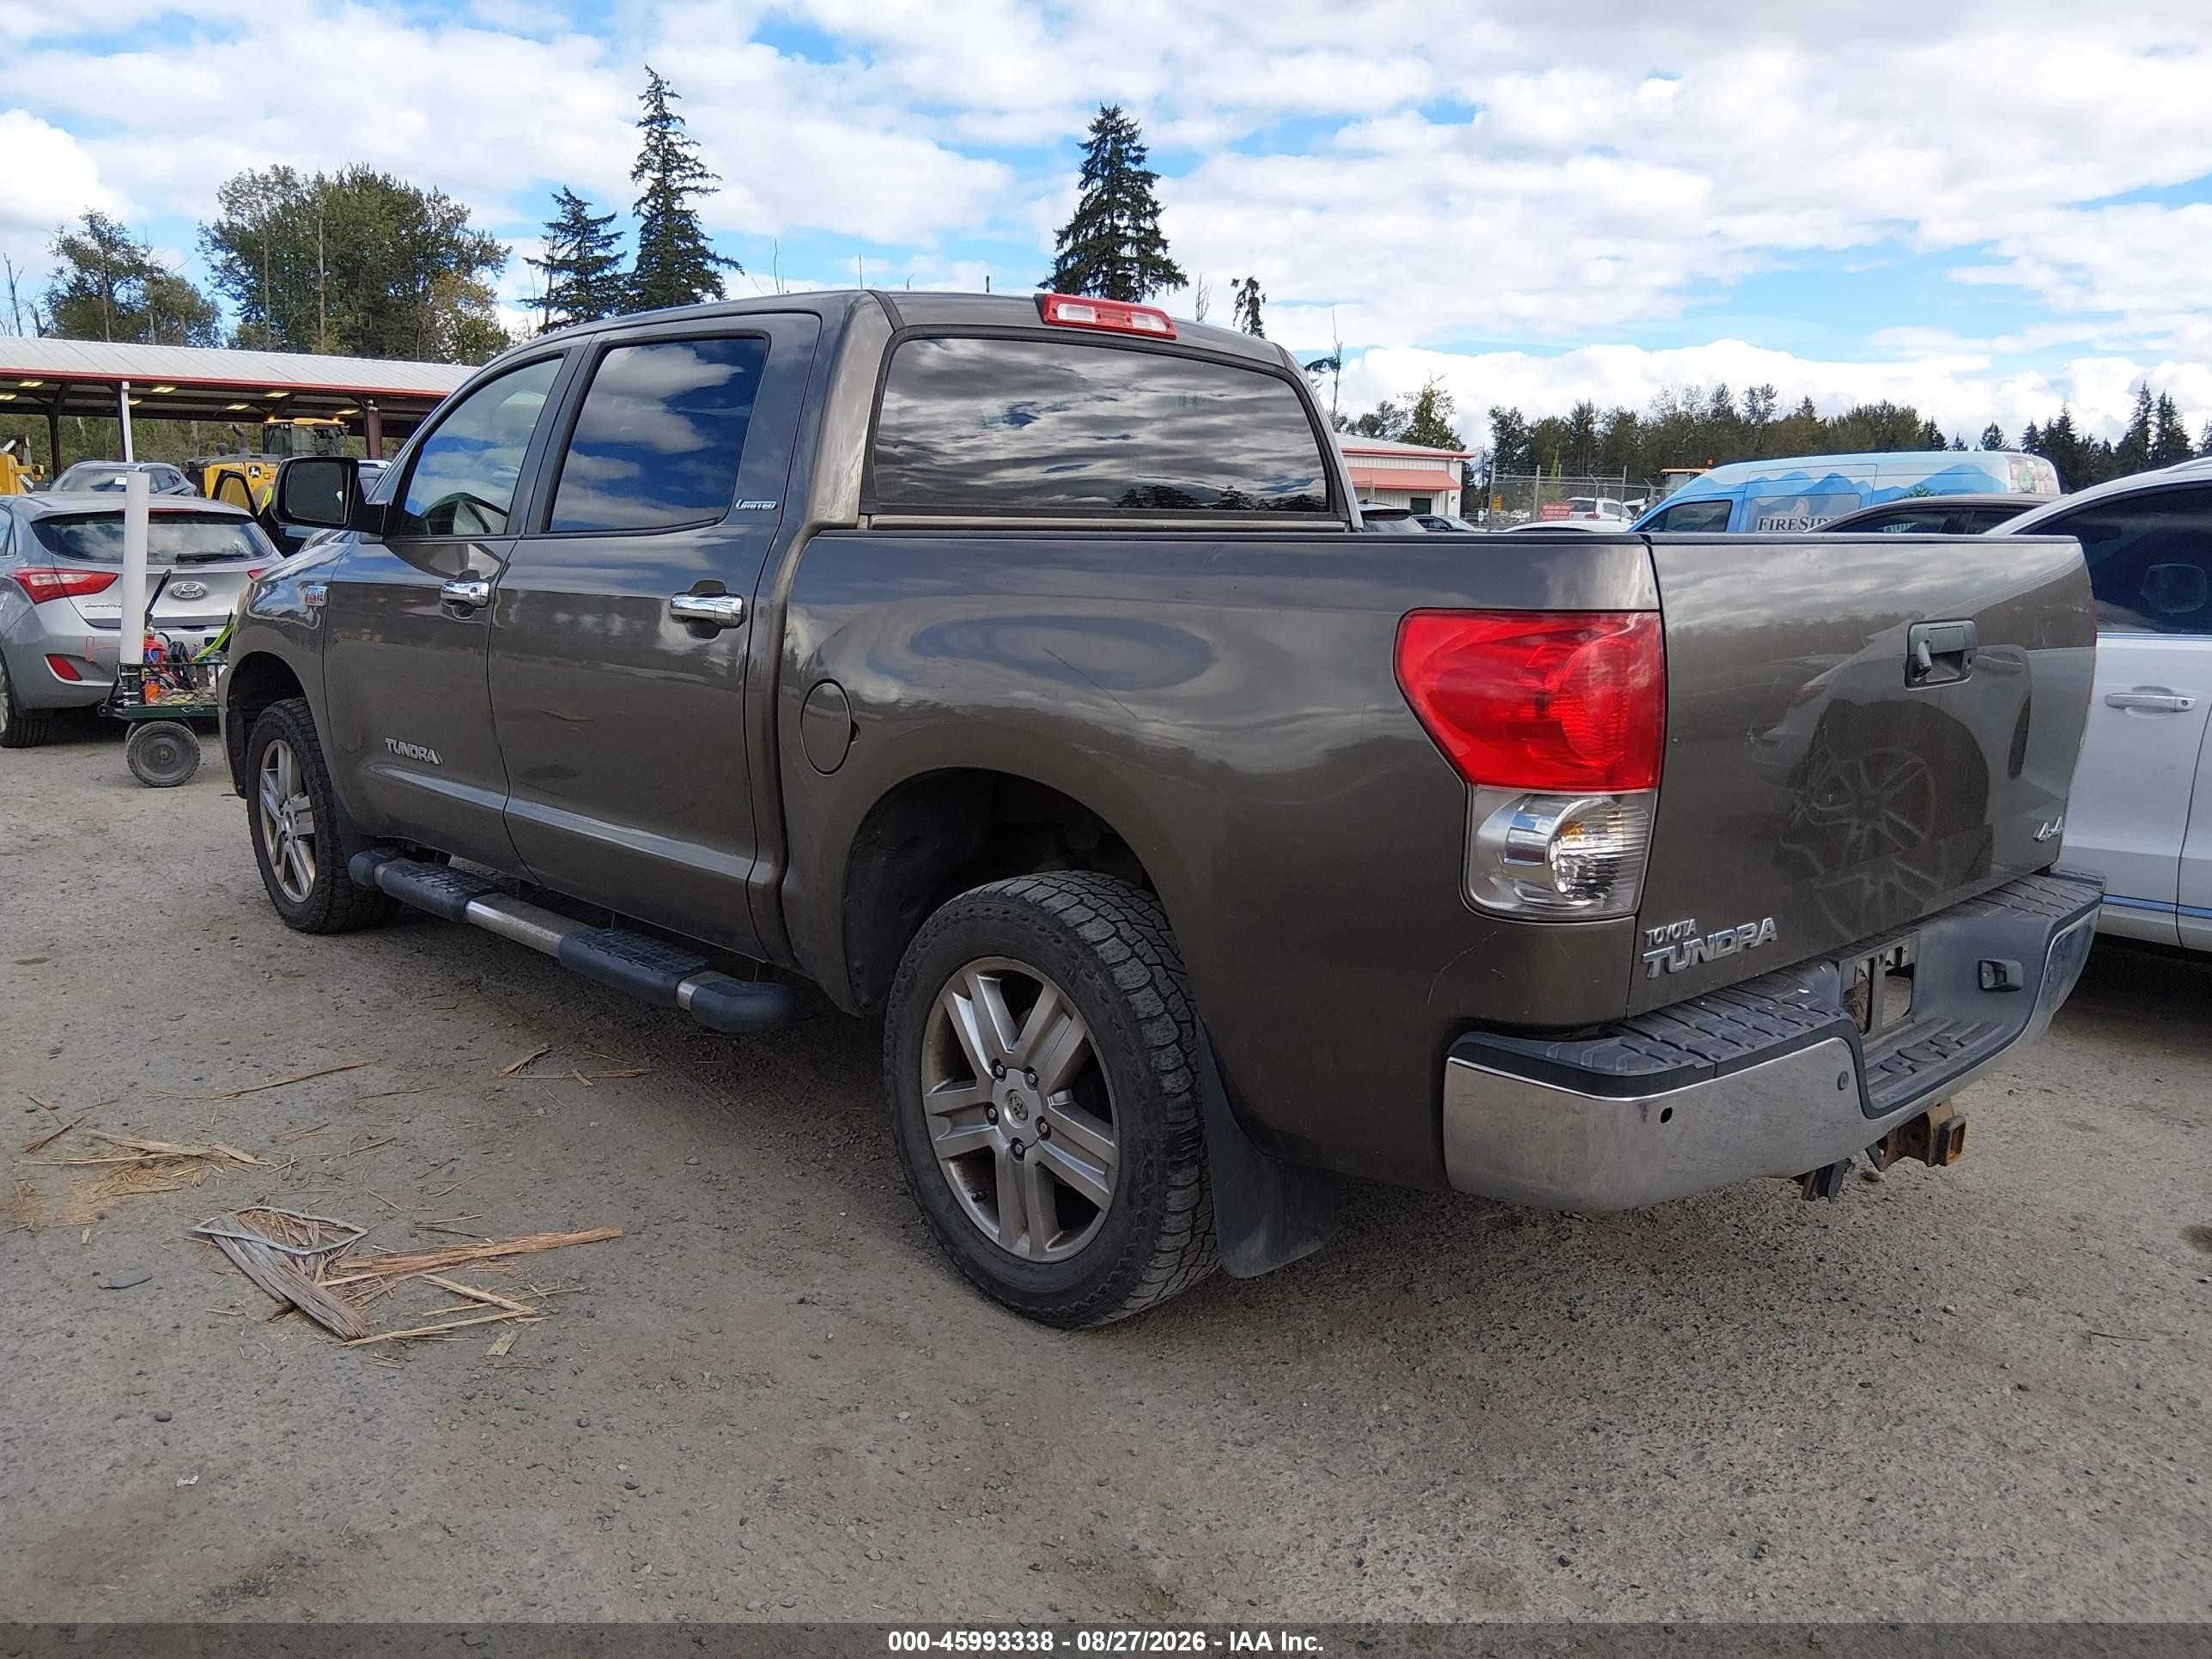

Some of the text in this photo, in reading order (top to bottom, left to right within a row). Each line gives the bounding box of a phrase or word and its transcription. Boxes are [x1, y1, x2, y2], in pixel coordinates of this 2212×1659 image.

[385, 738, 441, 764] TUNDRA
[1644, 919, 1697, 946] TOYOTA
[1641, 917, 1778, 979] TUNDRA
